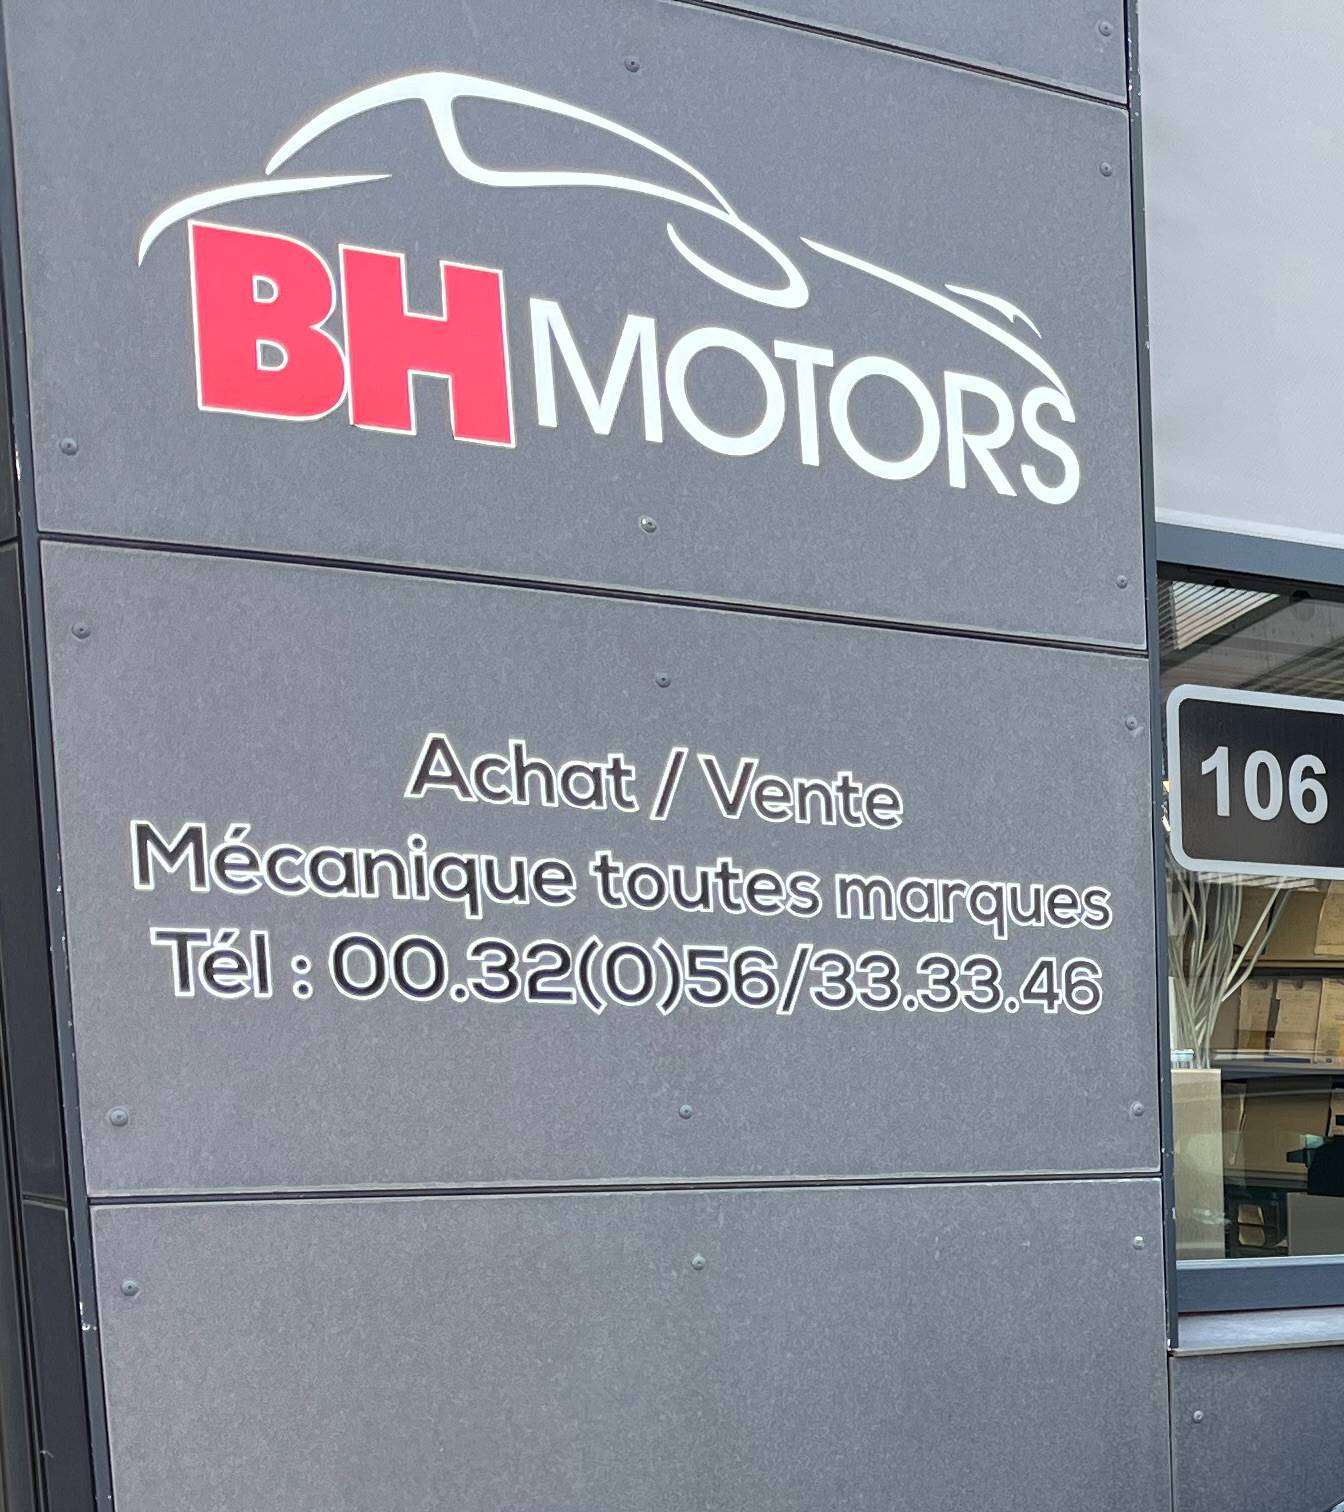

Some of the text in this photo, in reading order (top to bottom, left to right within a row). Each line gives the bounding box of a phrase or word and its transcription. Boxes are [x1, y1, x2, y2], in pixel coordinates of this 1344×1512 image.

[187, 219, 1081, 505] BH MOTORS
[403, 732, 905, 831] Achat / Vente
[1200, 745, 1329, 825] 106
[129, 818, 1114, 941] Mécanique toutes marques
[149, 925, 273, 1000] Tél
[327, 932, 1103, 1016] 00.32(0)56/33.33.46
